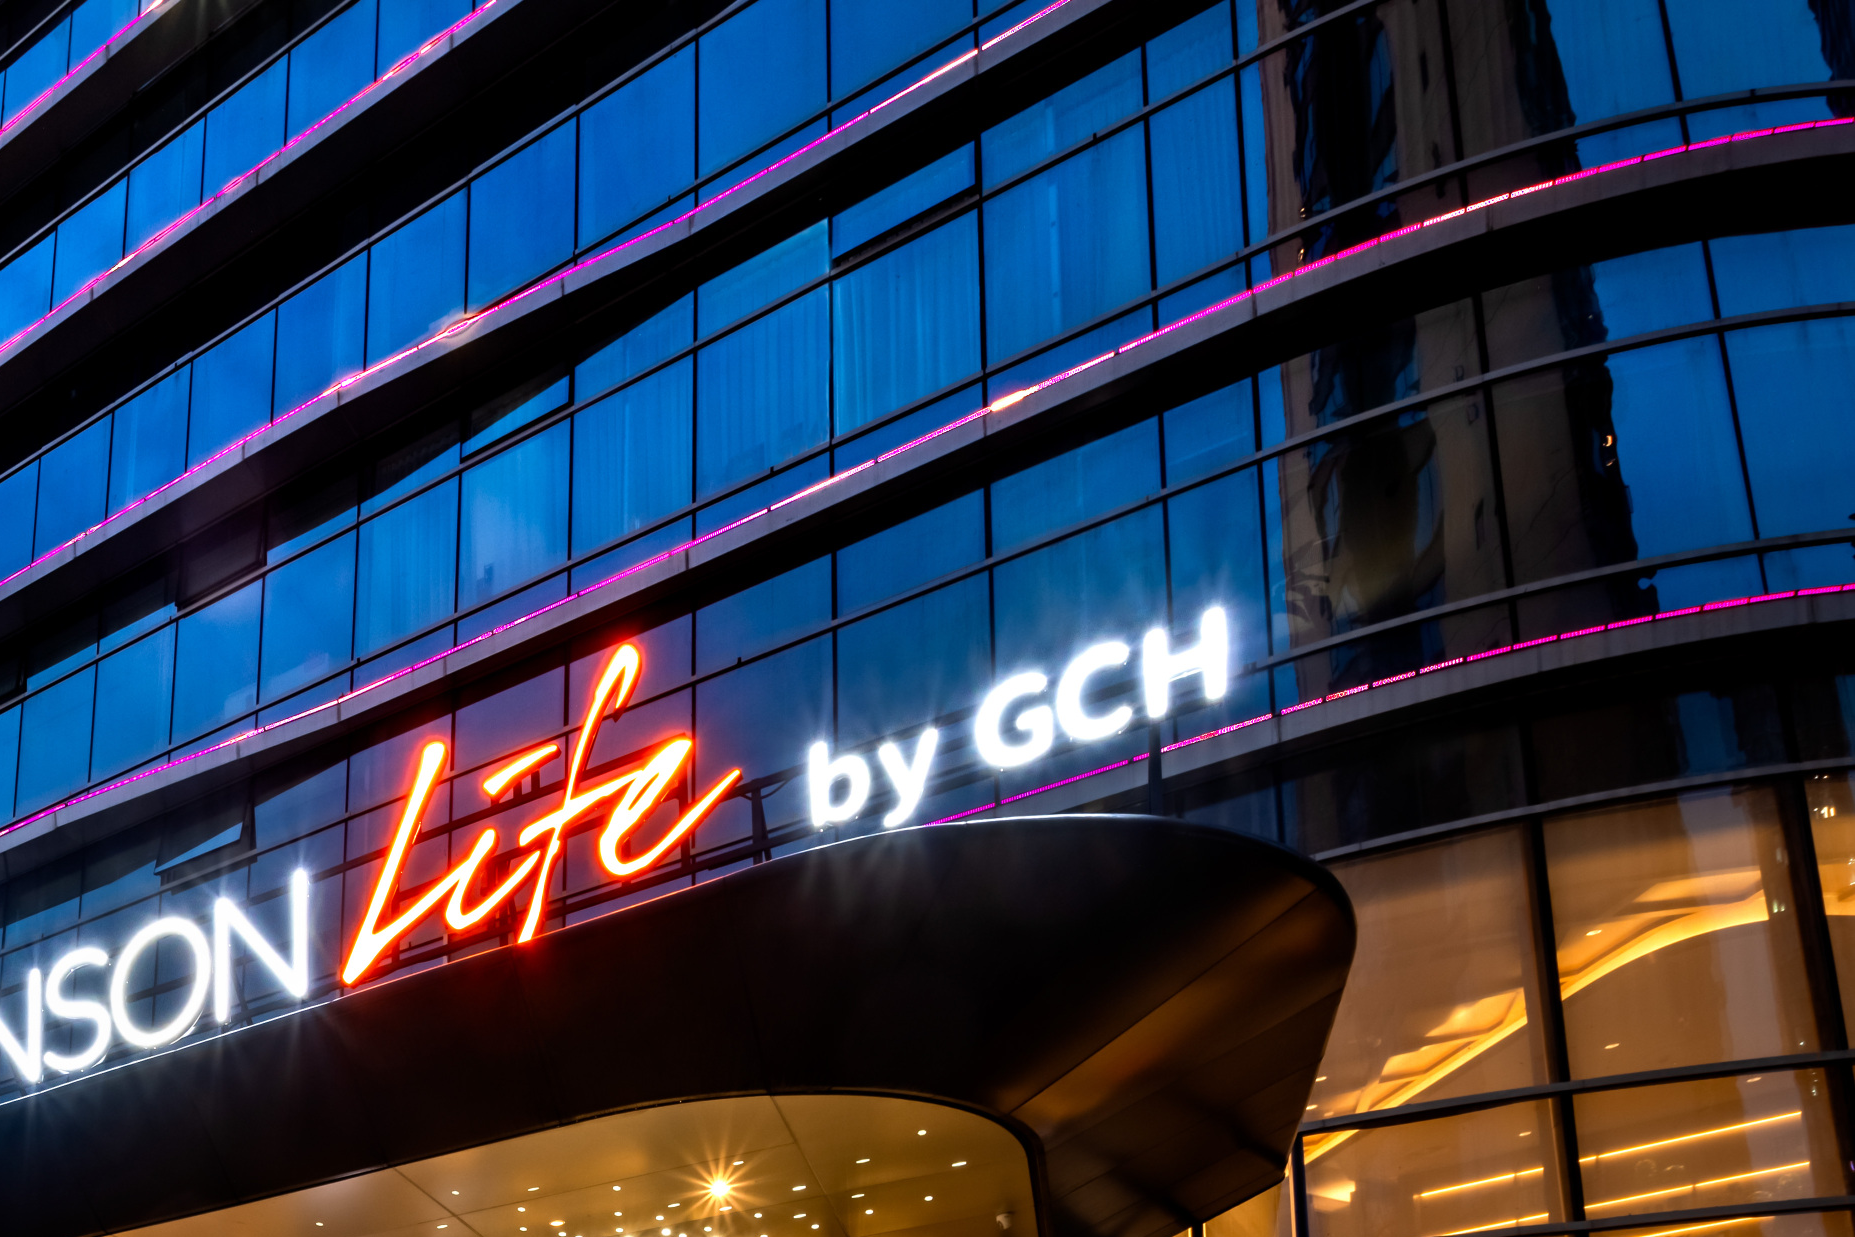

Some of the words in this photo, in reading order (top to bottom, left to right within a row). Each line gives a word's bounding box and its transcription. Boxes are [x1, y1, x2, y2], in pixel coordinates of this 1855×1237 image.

[340, 643, 743, 986] Life
[806, 727, 939, 828] by
[974, 604, 1232, 770] GCH
